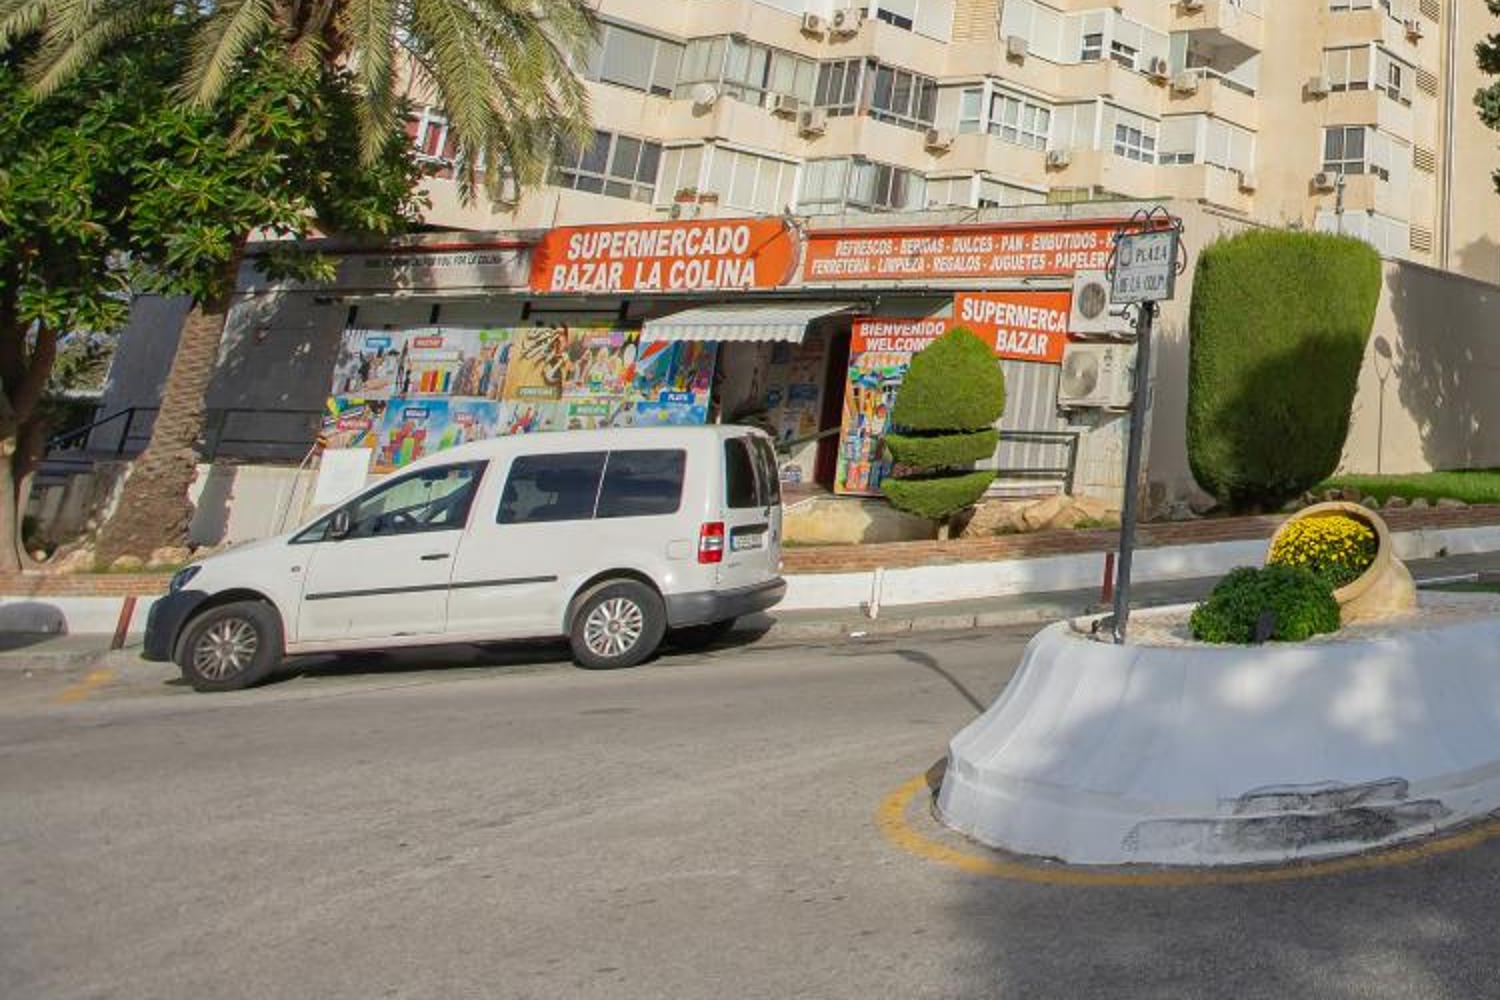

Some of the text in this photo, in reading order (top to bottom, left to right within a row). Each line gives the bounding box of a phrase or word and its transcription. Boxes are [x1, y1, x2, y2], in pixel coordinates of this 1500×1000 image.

[567, 225, 749, 260] SUPERMERCADO
[835, 239, 893, 257] REFRESCOS
[952, 236, 993, 252] DULCES
[1001, 234, 1024, 250] PAN
[1031, 232, 1096, 250] EMBUTIDOS
[552, 259, 755, 290] BAZAR LA COLINA
[878, 257, 924, 273] LIMPIEZA
[933, 256, 980, 272] REGALOS
[989, 253, 1045, 270] JUGUETES
[961, 298, 1066, 333] SUPERMERCA
[860, 322, 945, 336] BIENVENIDO
[995, 329, 1048, 355] BAZAR
